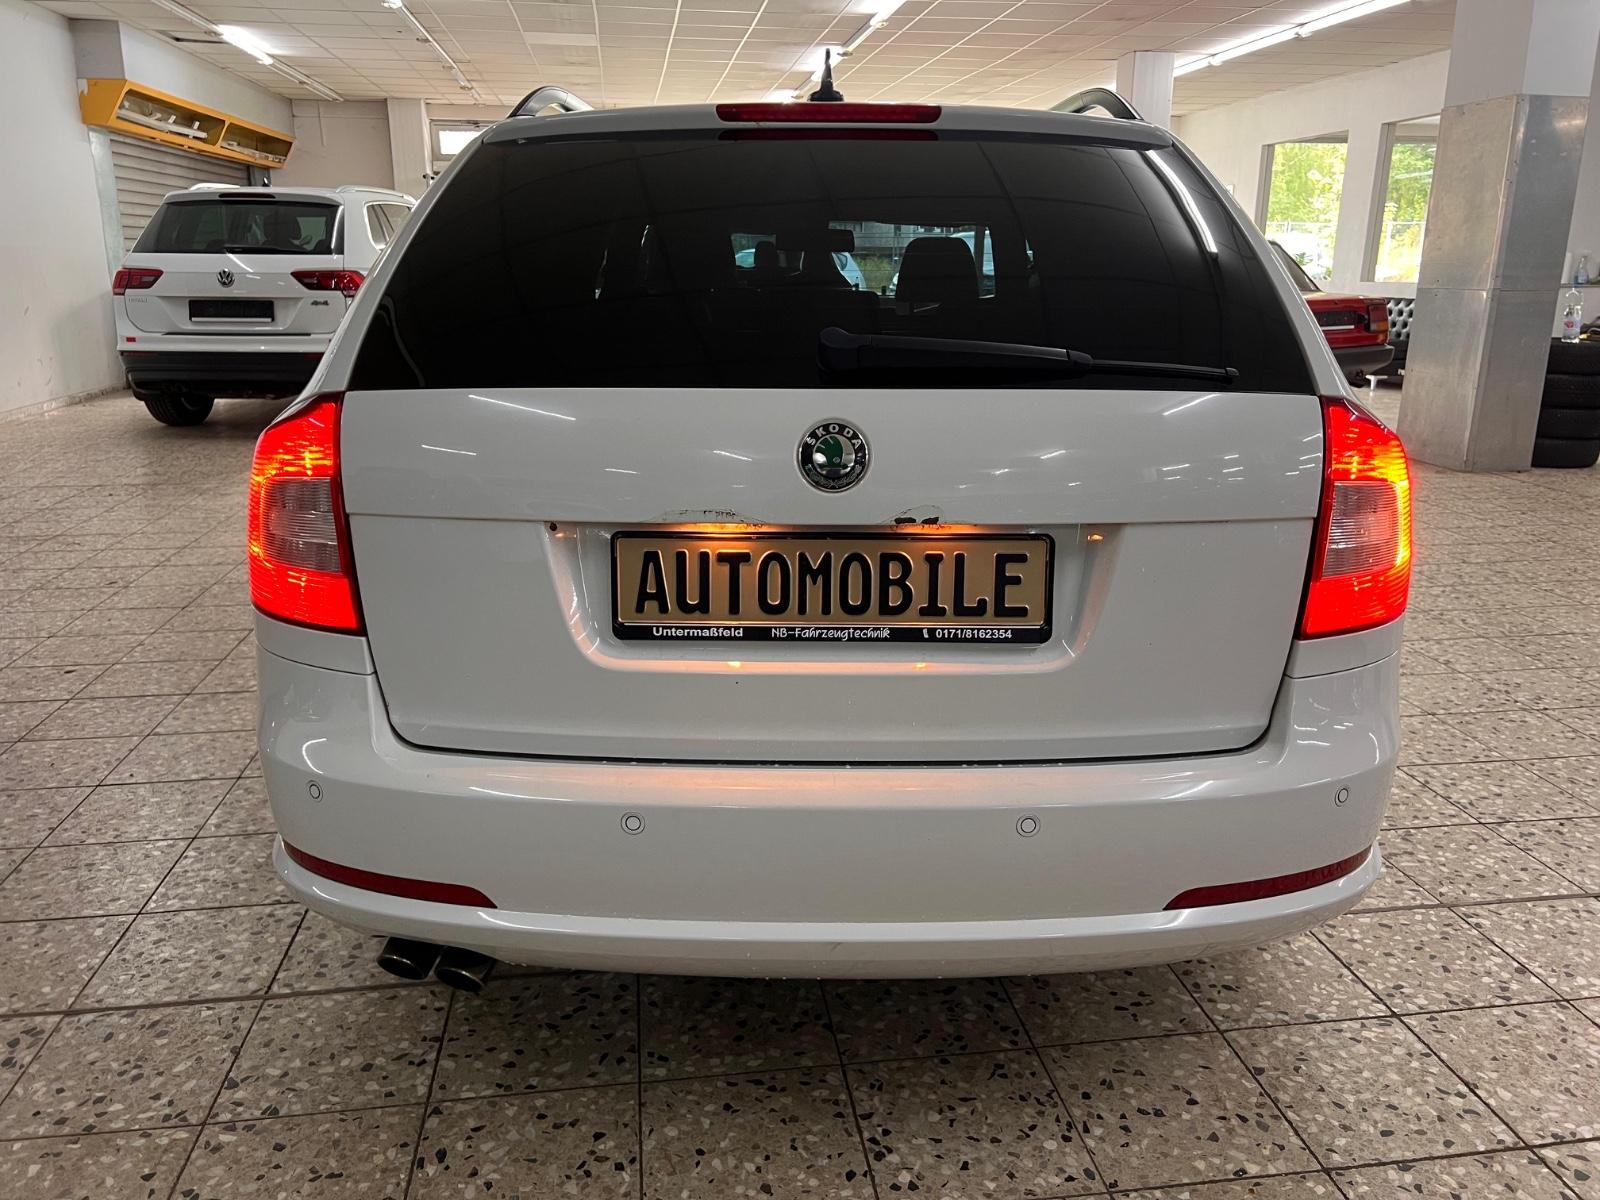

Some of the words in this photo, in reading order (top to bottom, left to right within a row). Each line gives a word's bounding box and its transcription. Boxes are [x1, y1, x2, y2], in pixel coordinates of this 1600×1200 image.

[635, 549, 1029, 618] AUTOMOBILE
[652, 626, 743, 637] Untermaßfeld
[771, 626, 890, 641] NB-Fahrzeugtechnik
[935, 629, 1012, 639] 0171/8162354
